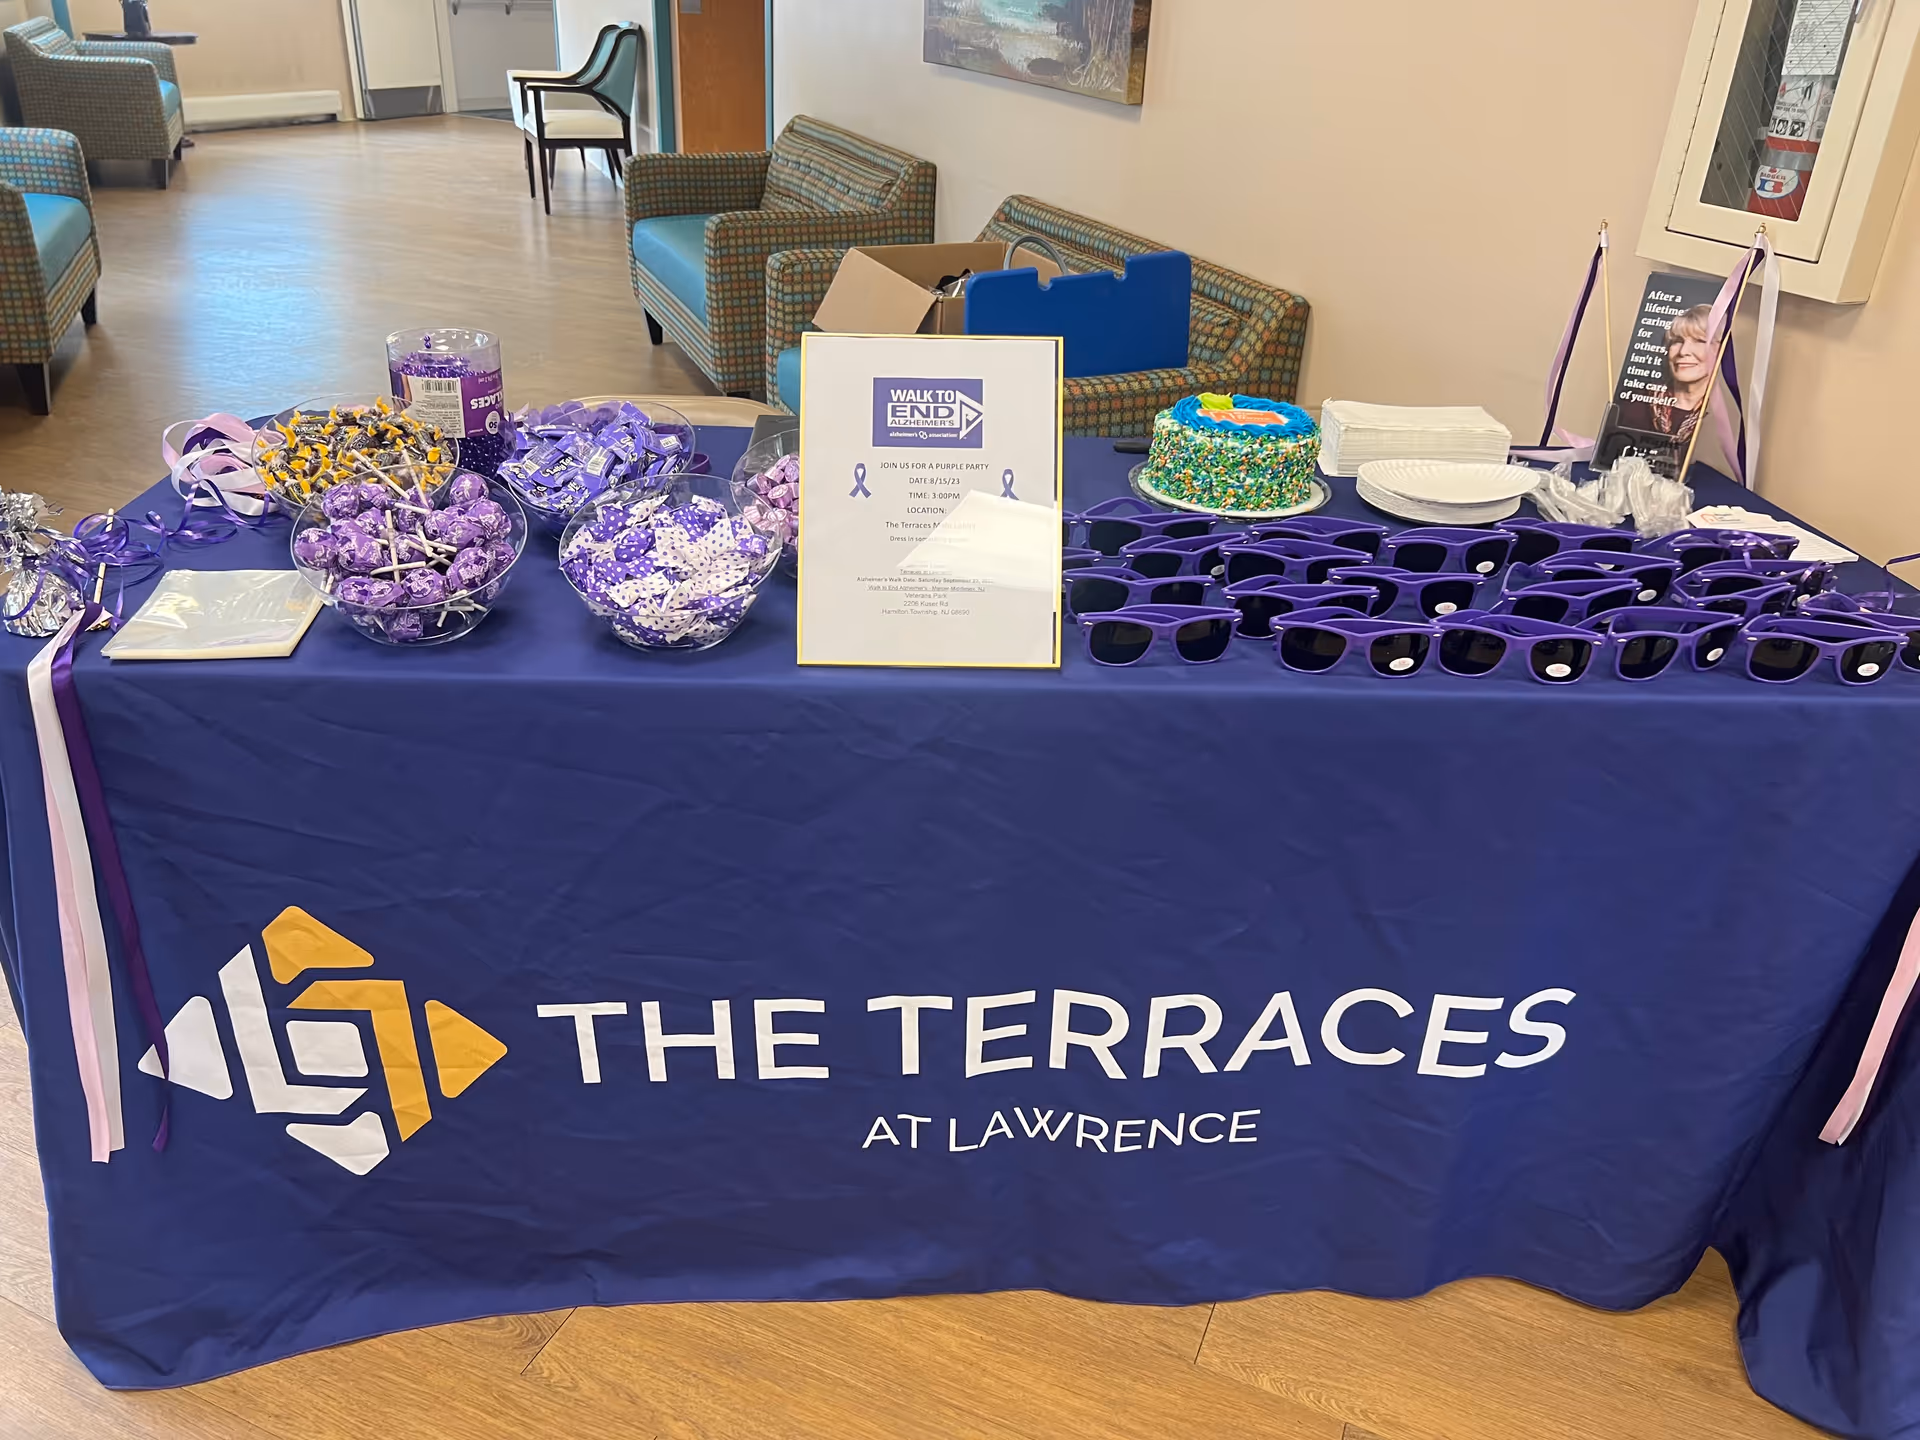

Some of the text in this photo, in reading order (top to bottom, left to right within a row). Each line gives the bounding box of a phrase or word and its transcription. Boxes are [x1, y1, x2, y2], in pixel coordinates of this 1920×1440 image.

[1647, 290, 1682, 303] After a
[1644, 303, 1686, 316] lifetime
[1640, 317, 1673, 330] caring
[1637, 329, 1653, 338] for
[1633, 341, 1668, 356] others,
[1630, 353, 1662, 366] isn't it
[1626, 365, 1662, 378] time to
[1623, 379, 1668, 392] take care
[890, 389, 954, 403] WALK TO
[1620, 390, 1678, 407] of yourself?
[891, 405, 954, 418] END
[489, 421, 498, 429] 50
[932, 492, 960, 500] 3:00PM
[901, 521, 932, 529] Terraces
[536, 987, 1577, 1085] THE TERRACES
[862, 1106, 1262, 1154] AT LAWRENCE
